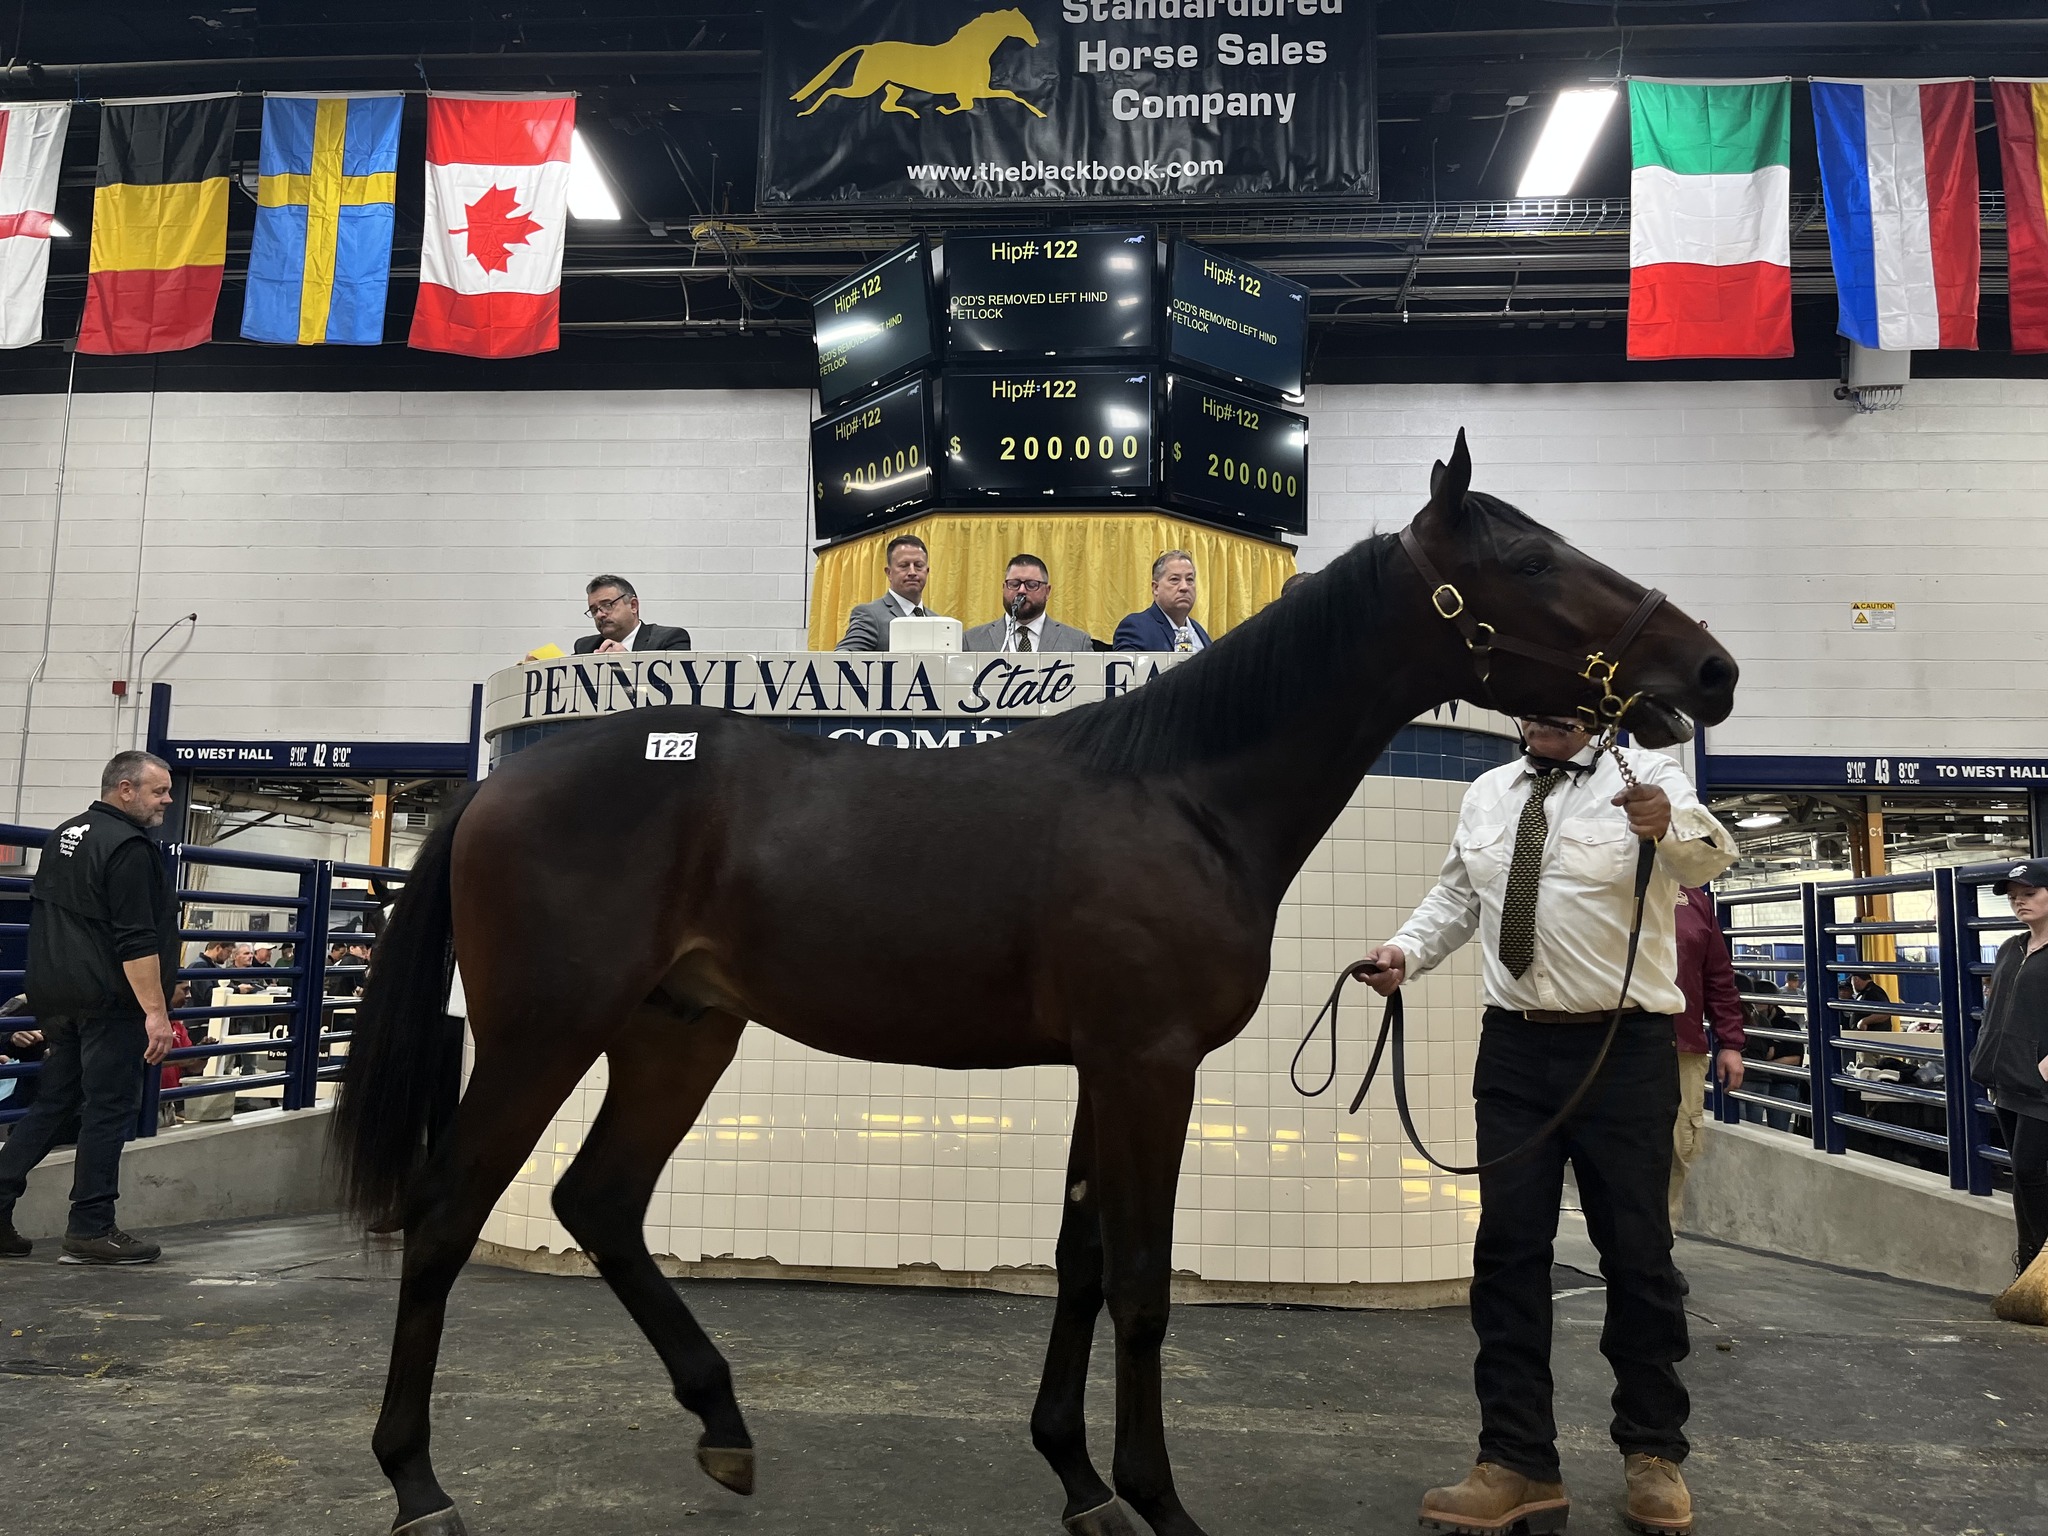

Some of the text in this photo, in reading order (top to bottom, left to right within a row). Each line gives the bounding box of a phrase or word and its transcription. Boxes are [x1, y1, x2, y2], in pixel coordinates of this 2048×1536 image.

[1078, 33, 1328, 73] Horse Sales
[1112, 88, 1297, 124] Company
[907, 158, 1224, 182] www.theblackbook.com
[1043, 240, 1078, 259] 122
[861, 275, 882, 299] 122
[1238, 274, 1261, 298] 122
[950, 291, 1108, 307] OCD'S REMOVED LEFT HIND
[886, 313, 903, 330] HIND
[950, 308, 1003, 320] FETLOCK
[1172, 298, 1278, 346] OCD'S REMOVED LEFT HIND
[1172, 311, 1209, 334] FETLOCK
[820, 355, 848, 377] FETLOCK
[950, 435, 962, 455] $
[1173, 441, 1182, 462] $
[521, 658, 943, 720] PENNSYLVANIA
[957, 658, 1077, 714] State
[176, 747, 274, 760] TO WEST HALL
[312, 743, 327, 768] 42
[651, 739, 694, 758] 122
[1874, 758, 1890, 785] 43
[1936, 765, 1958, 778] TO
[1961, 765, 2006, 778] WEST
[2009, 766, 2048, 779] HALL
[373, 810, 384, 820] A1
[1869, 827, 1882, 837] C1
